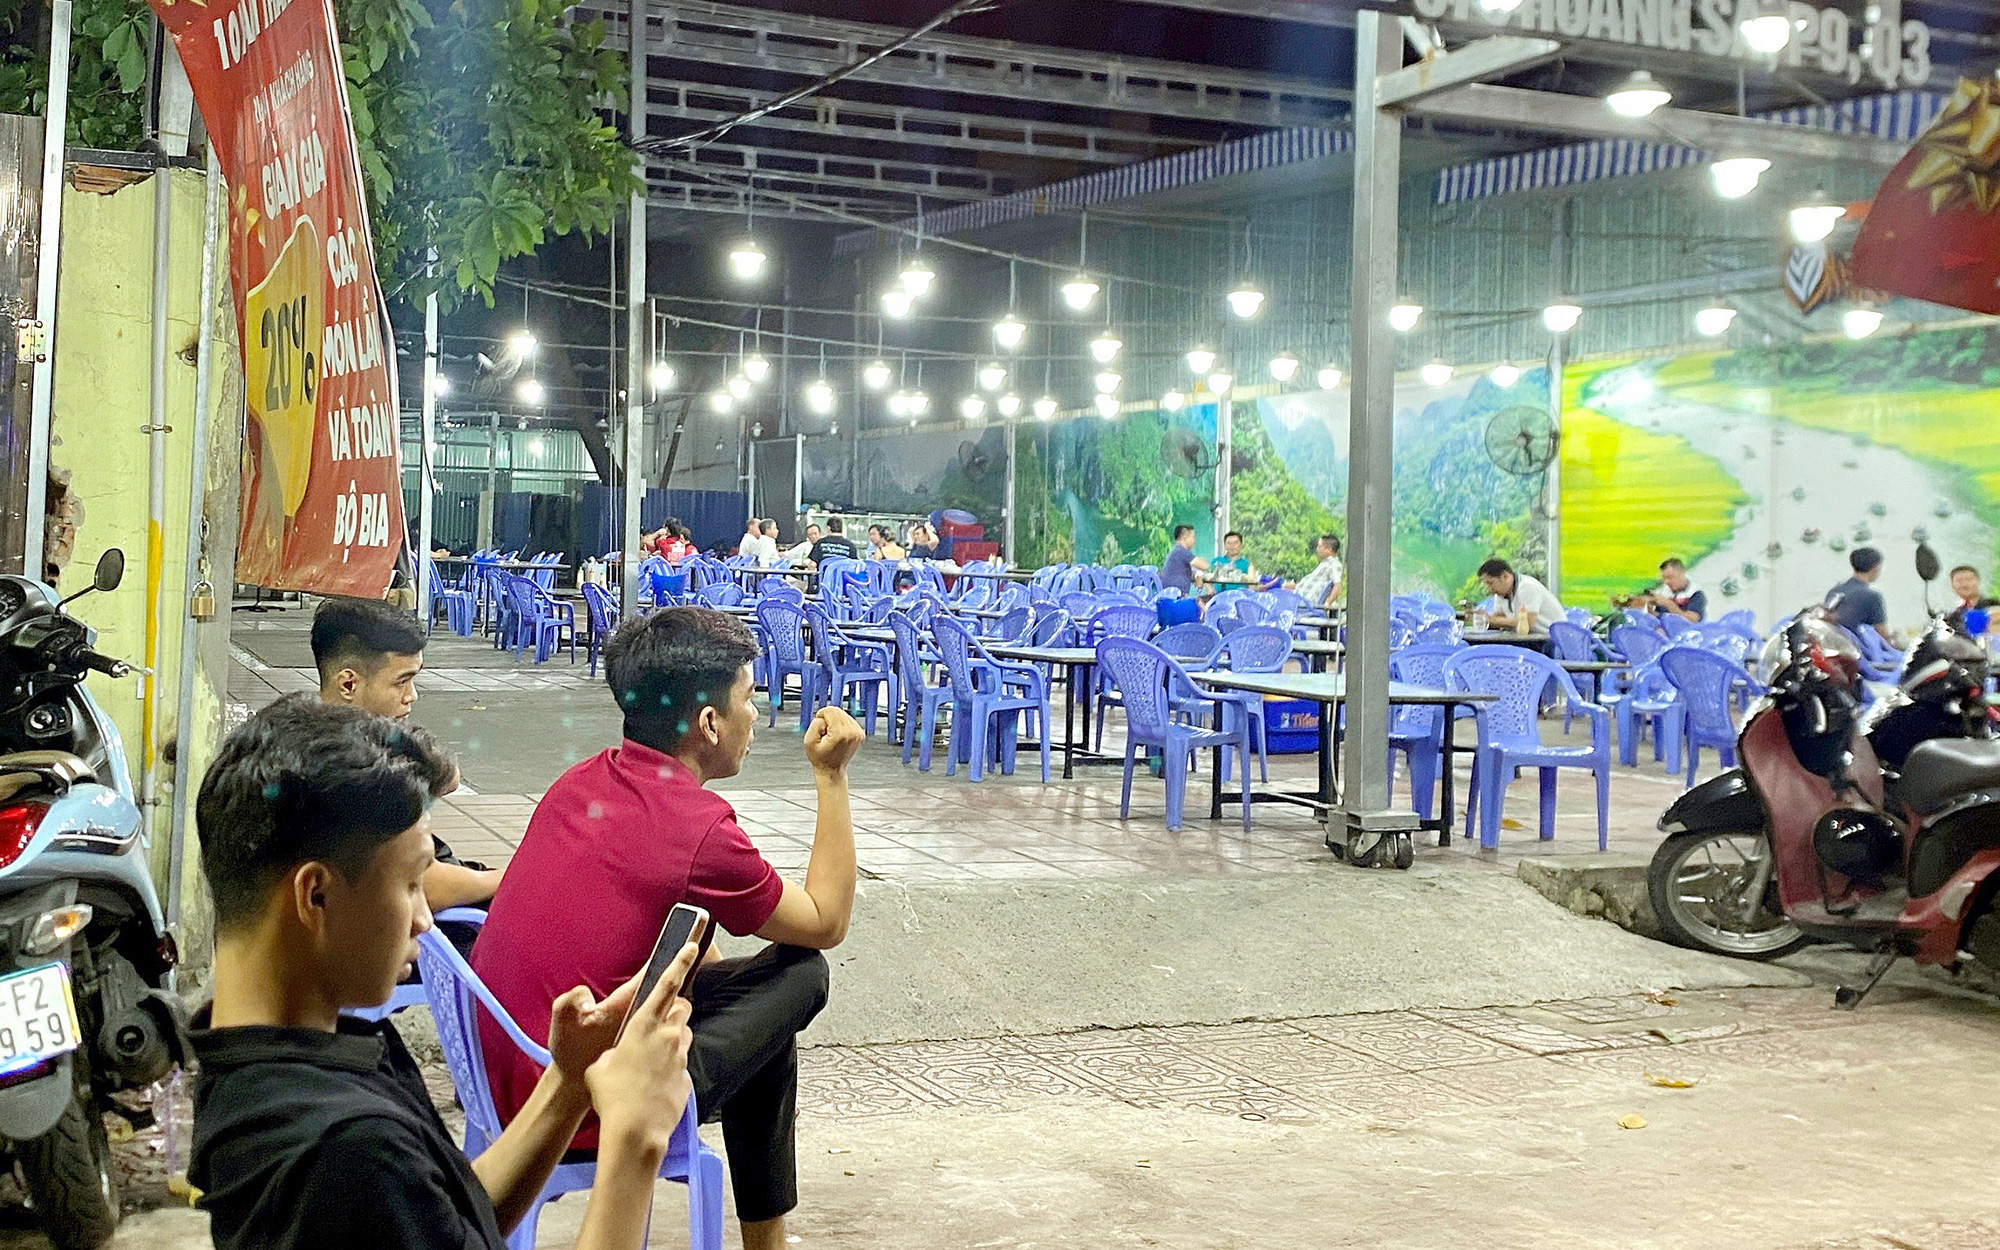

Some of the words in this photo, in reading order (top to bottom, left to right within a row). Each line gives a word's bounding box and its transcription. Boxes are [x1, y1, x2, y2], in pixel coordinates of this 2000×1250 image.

[300, 112, 328, 199] GIÁ
[327, 216, 358, 289] CÁC
[261, 295, 315, 412] 20%
[322, 308, 357, 379] MÓN
[328, 394, 351, 462] VÀ
[350, 389, 393, 460] TOÀN
[333, 479, 359, 563] BỘ
[358, 492, 389, 548] BIA
